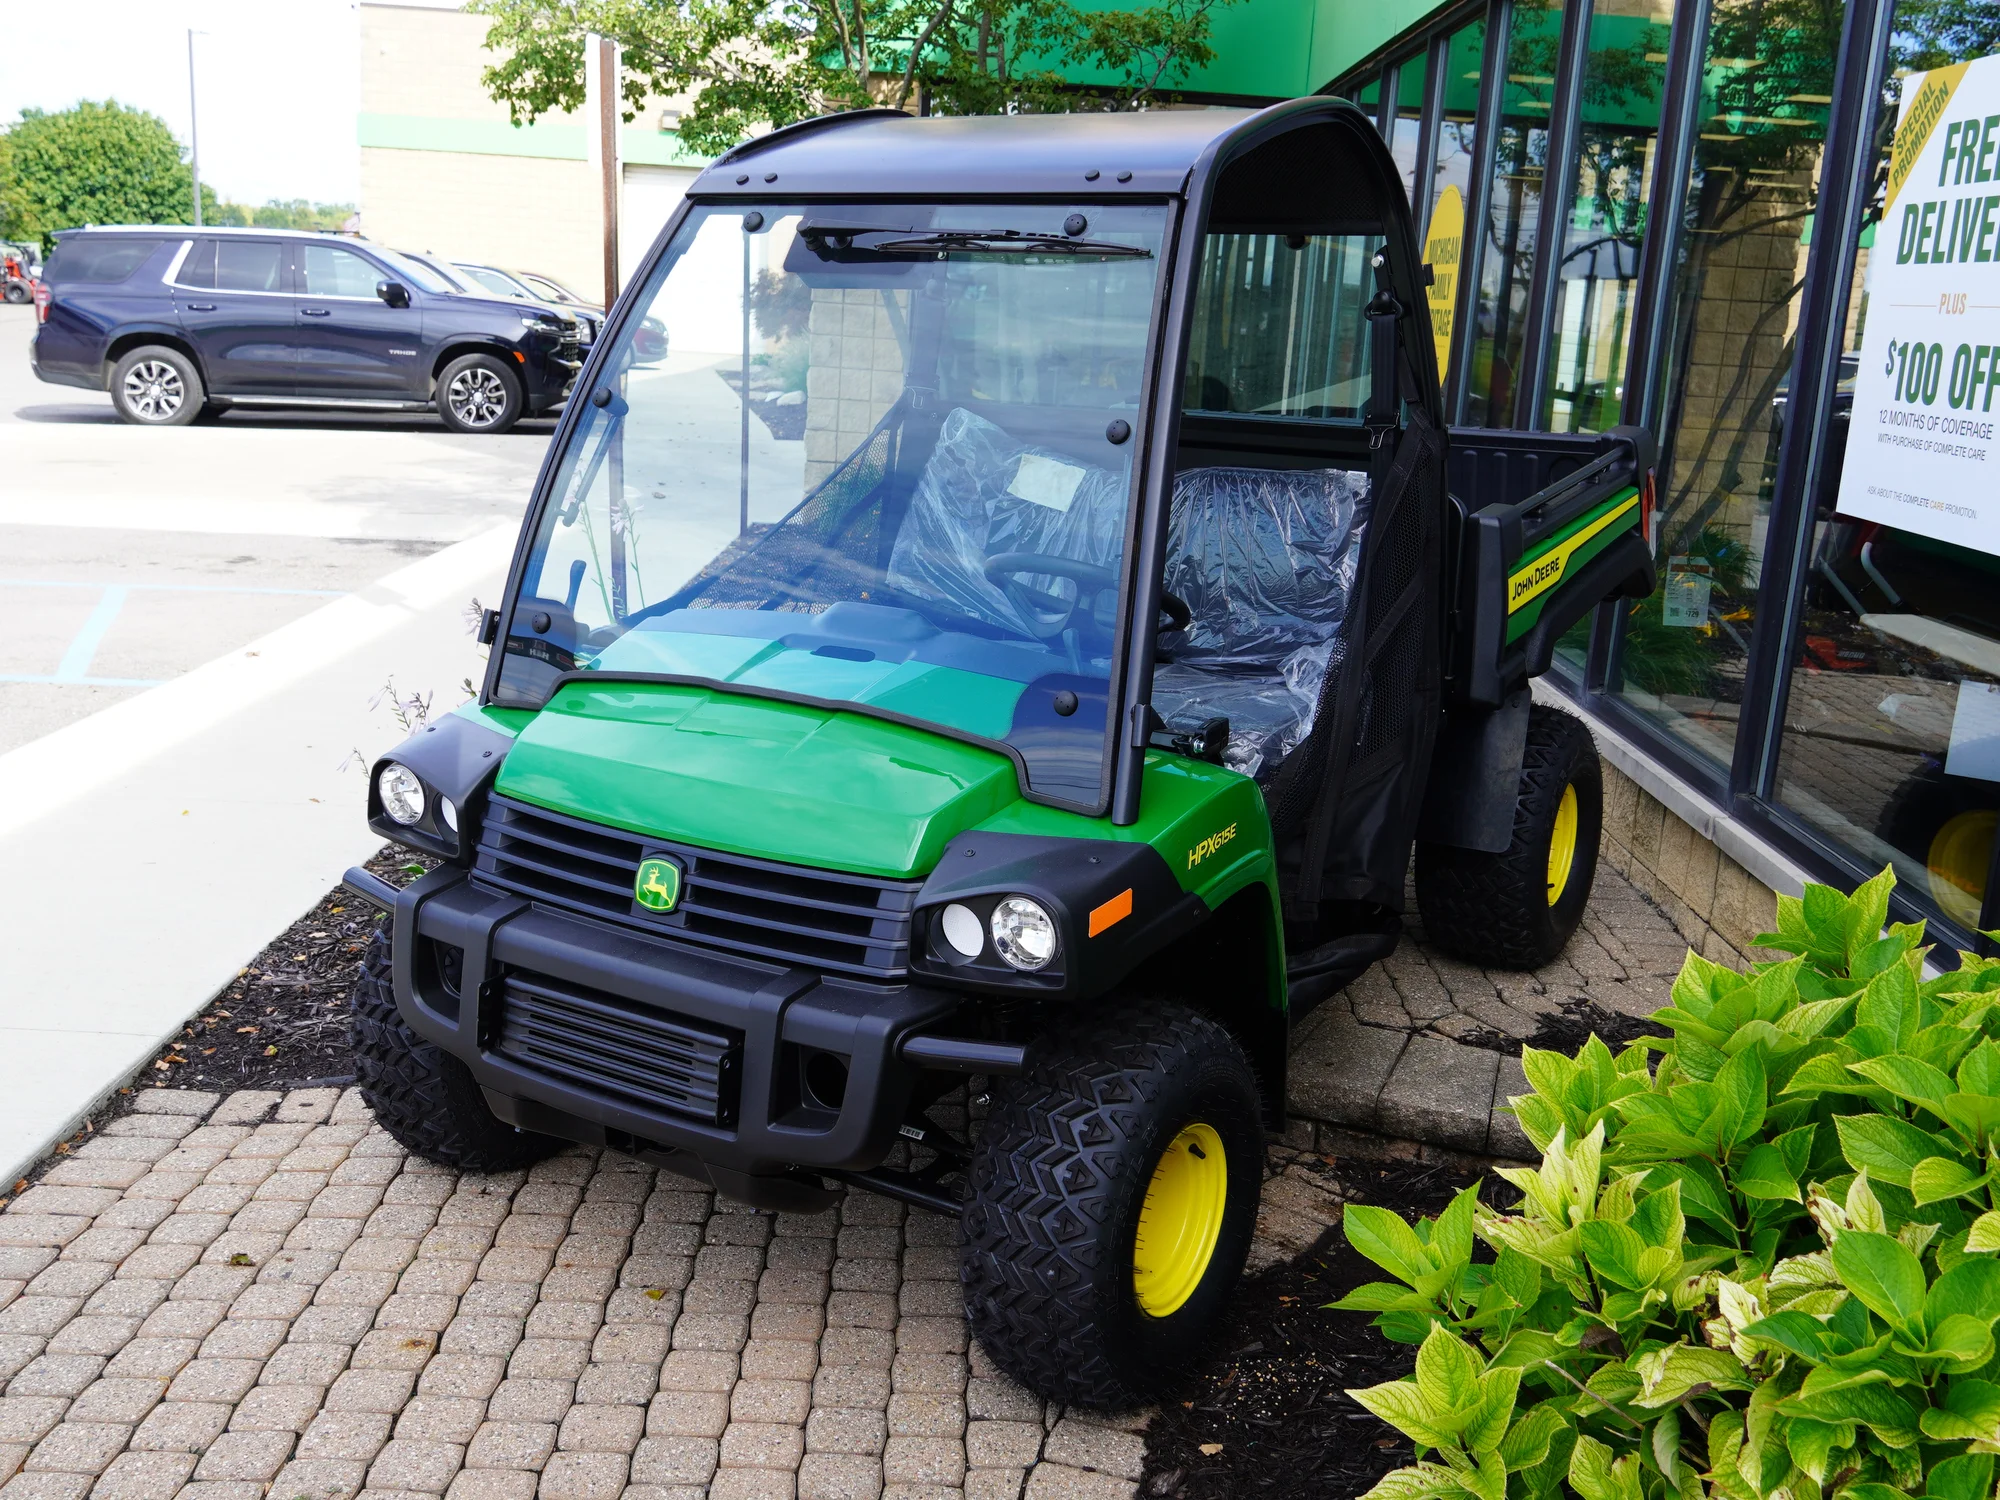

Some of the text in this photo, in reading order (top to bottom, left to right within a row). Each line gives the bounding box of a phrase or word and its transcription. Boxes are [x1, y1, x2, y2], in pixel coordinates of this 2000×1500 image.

[1893, 80, 1949, 188] PROMOTION
[1896, 82, 1936, 156] SPECIAL
[1938, 115, 2000, 187] FRE
[1428, 236, 1460, 265] MICHIGAN
[1896, 196, 2000, 265] DELIVE
[1939, 293, 1967, 315] PLUS
[1886, 337, 2000, 413] $100 OFF
[1878, 433, 1986, 461] WITH PURCHASE OF COMPLETE CARE
[1879, 409, 1994, 440] 12 MONTHS OF COVERAGE
[1867, 486, 1876, 495] ASK
[1877, 488, 1893, 499] ABOUT
[1893, 491, 1903, 501] THE
[1903, 494, 1929, 508] COMPLETE
[1929, 500, 1944, 511] CARE
[1512, 557, 1560, 601] JOHN DEERE
[1188, 822, 1237, 870] HPX615E
